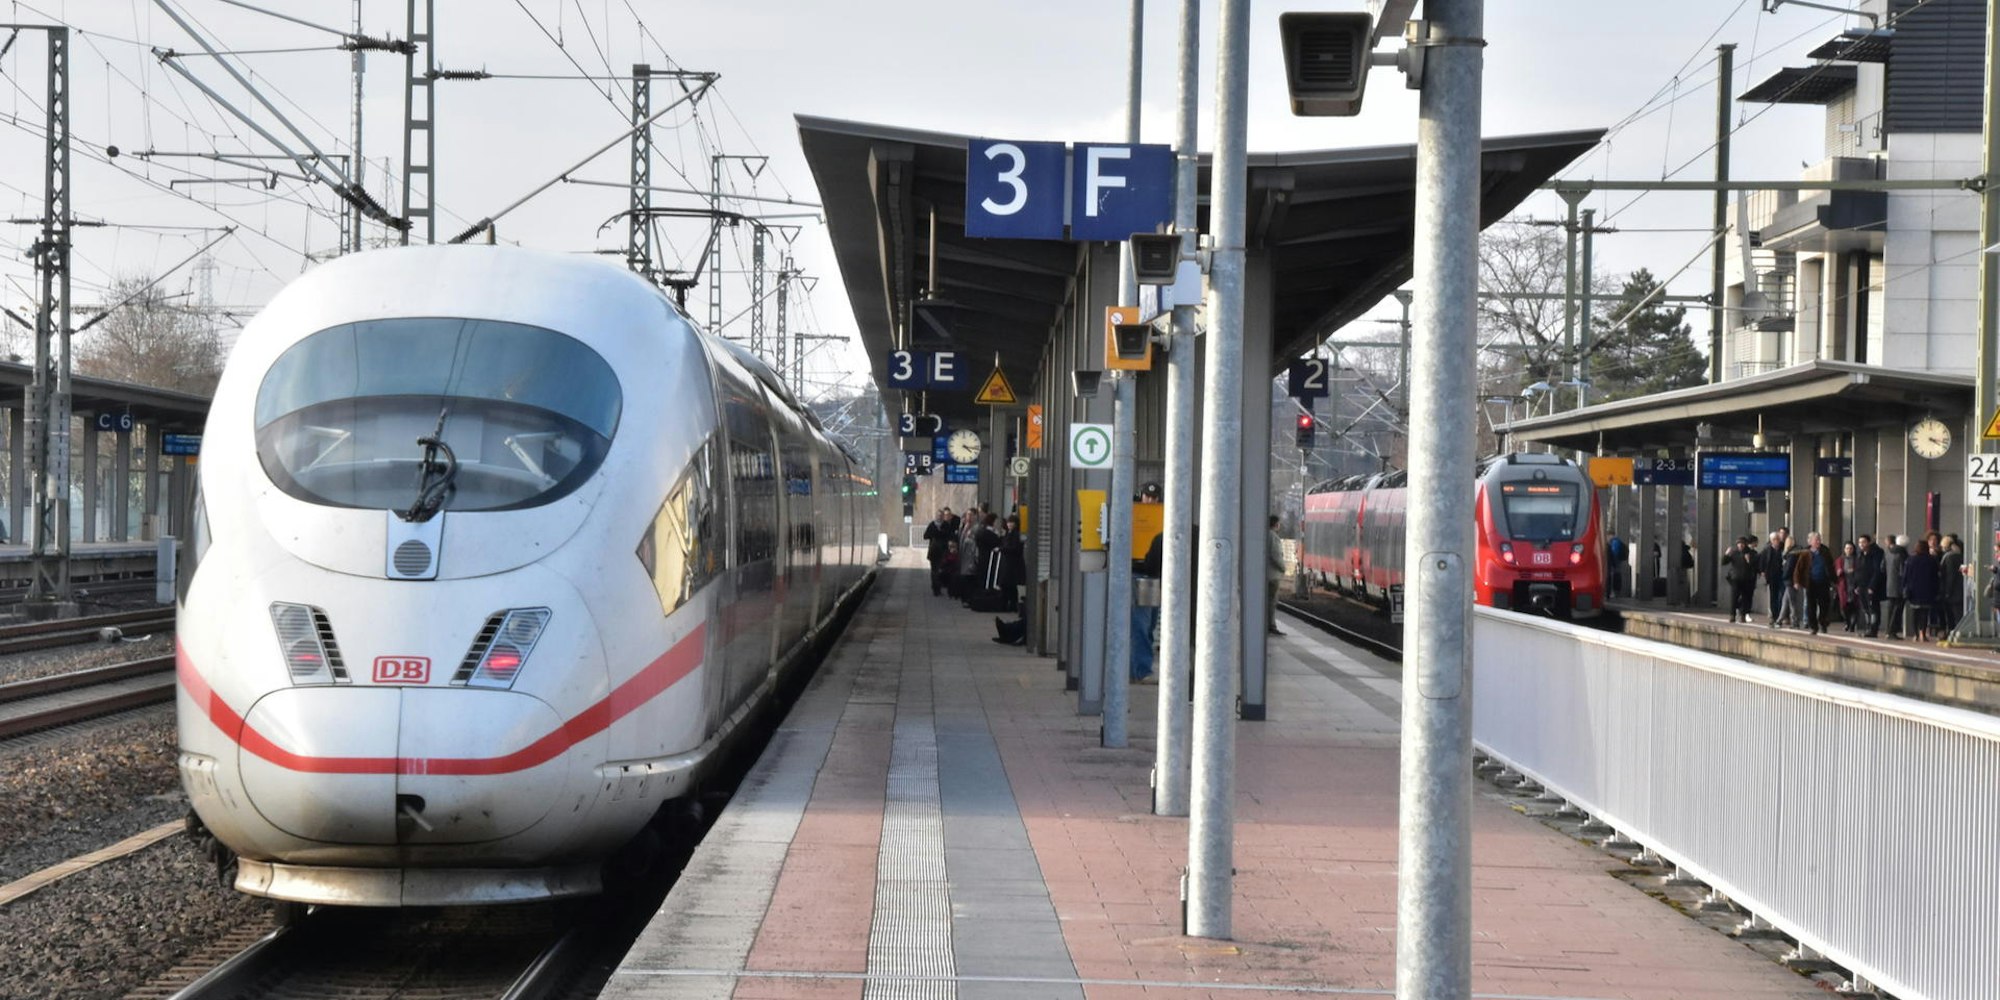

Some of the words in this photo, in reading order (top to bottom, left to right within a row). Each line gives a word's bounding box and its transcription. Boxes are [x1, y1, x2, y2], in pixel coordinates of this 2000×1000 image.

[981, 143, 1028, 216] 3
[1085, 147, 1131, 217] F
[893, 350, 913, 380] 3
[934, 352, 954, 381] E
[1304, 359, 1324, 389] 2
[99, 414, 110, 428] C
[120, 414, 131, 429] 6
[902, 413, 914, 433] 3
[907, 454, 916, 467] 3
[922, 455, 932, 467] B
[1656, 459, 1676, 471] 2-3
[1970, 457, 2000, 478] 24
[1977, 482, 1991, 501] 4
[1534, 553, 1551, 564] DB
[1392, 594, 1404, 611] H
[379, 659, 425, 680] DB
